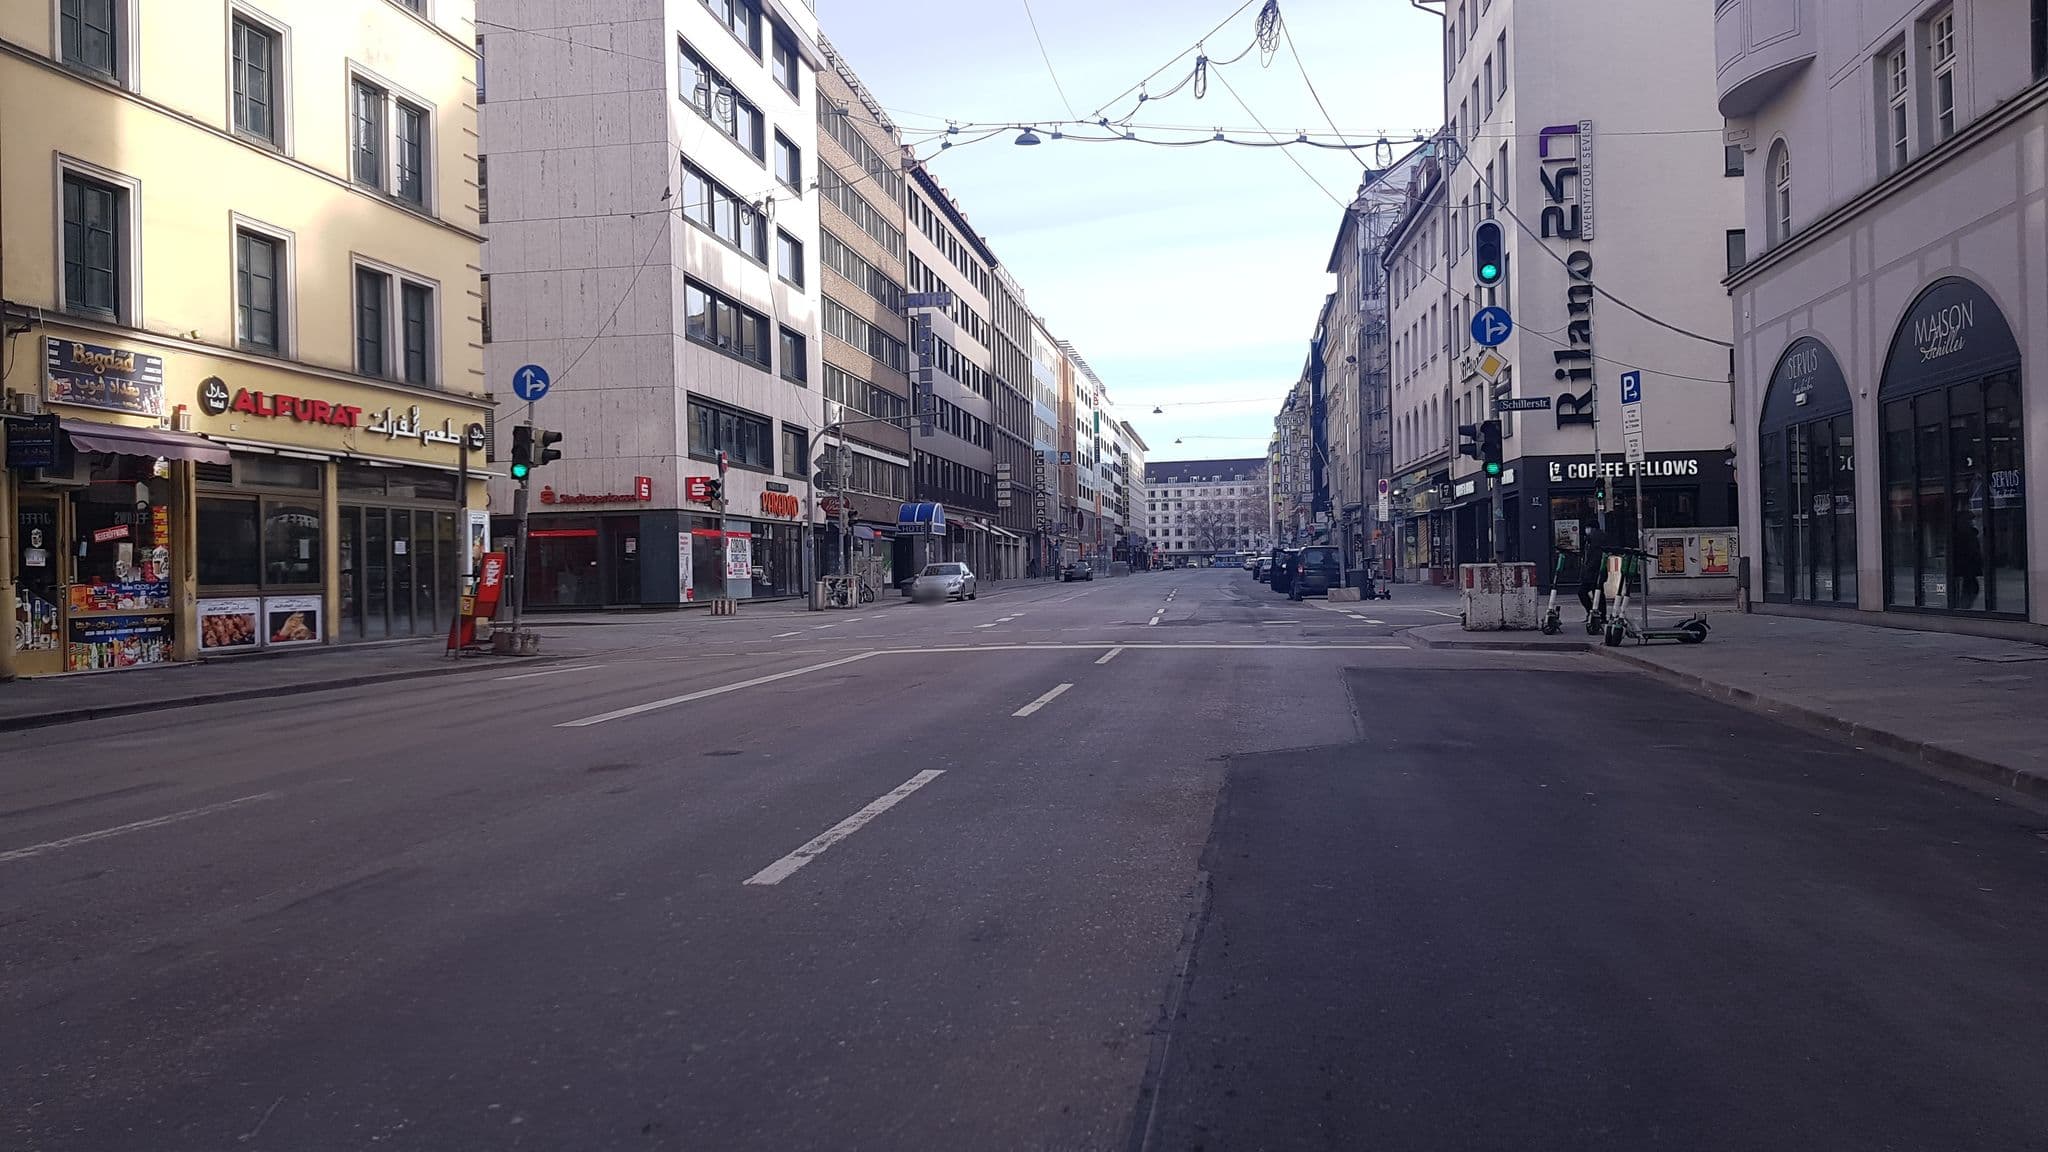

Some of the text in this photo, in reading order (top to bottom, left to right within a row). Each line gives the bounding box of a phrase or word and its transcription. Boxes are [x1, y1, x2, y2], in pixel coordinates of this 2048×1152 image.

[1582, 122, 1593, 238] TWENTYFOUR SEVEN
[1914, 299, 1974, 346] MAISON
[1553, 250, 1594, 430] Rilano
[72, 343, 136, 374] Bagdad
[1788, 347, 1818, 380] SERVUS
[205, 383, 228, 398] حلال
[1502, 399, 1549, 410] Schillerstr.
[1623, 375, 1635, 401] P
[233, 387, 362, 428] ALFURAT
[1302, 438, 1310, 493] HOTEL
[1567, 459, 1698, 479] COFFEE FELLOWS
